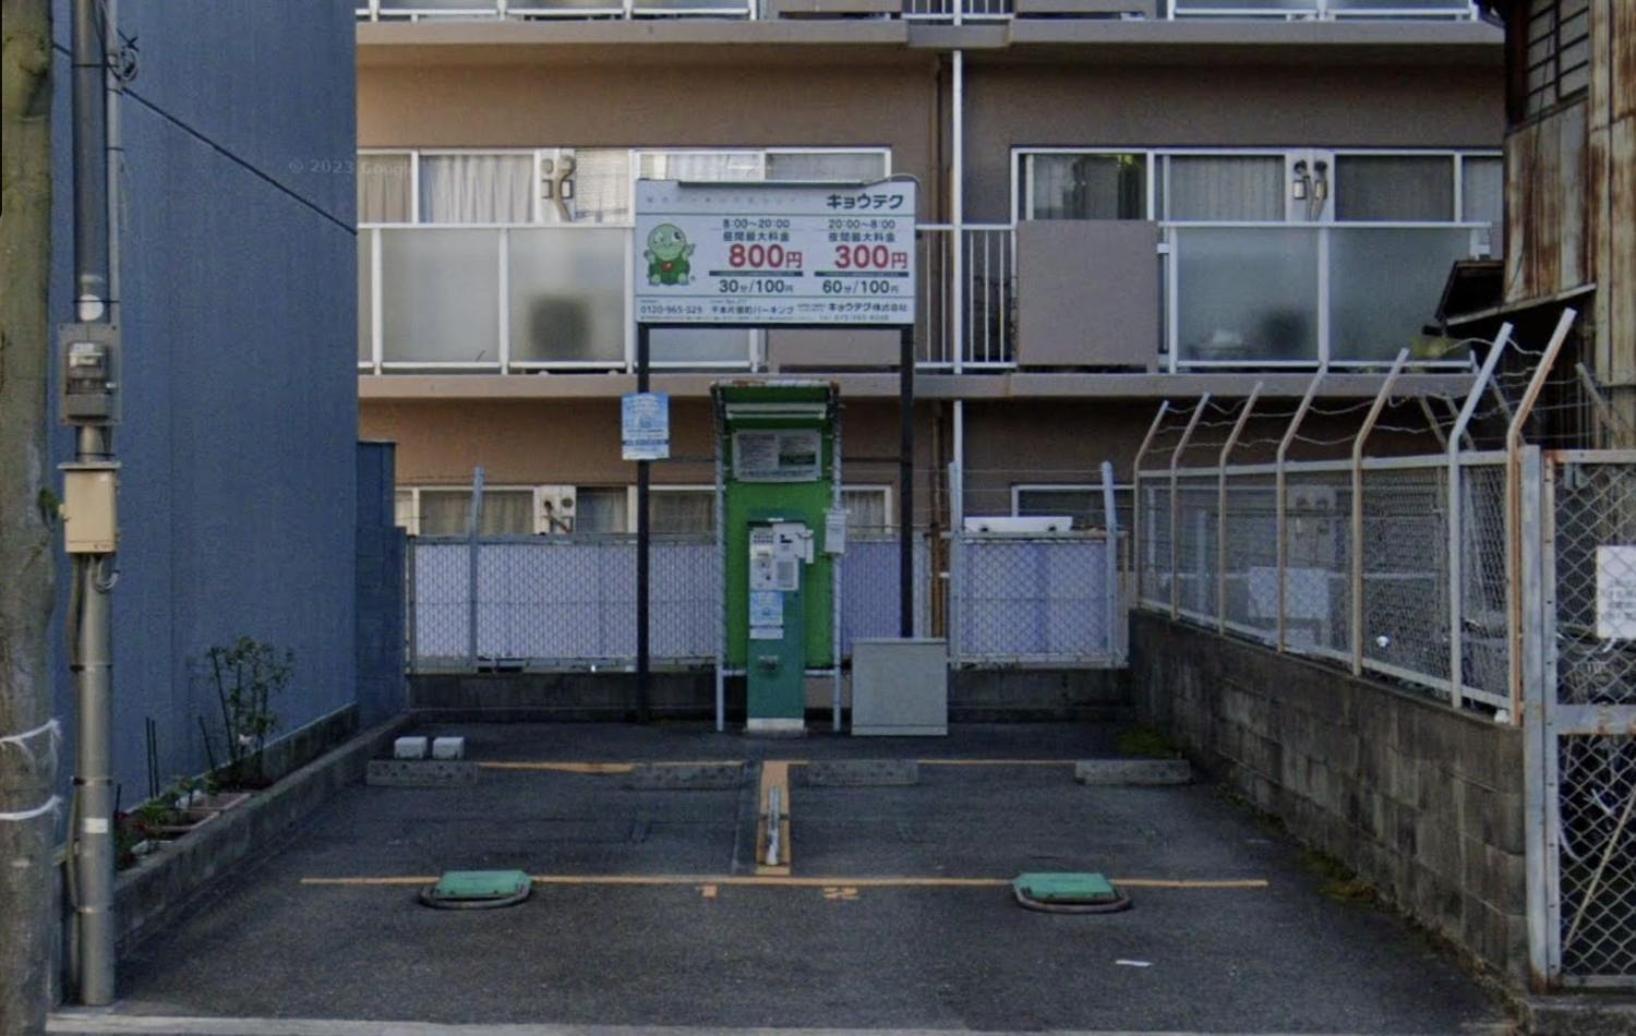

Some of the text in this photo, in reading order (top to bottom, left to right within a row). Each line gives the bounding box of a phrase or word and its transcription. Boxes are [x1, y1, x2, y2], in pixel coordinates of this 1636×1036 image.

[826, 194, 904, 210] キョウテク
[728, 243, 802, 269] 800円
[834, 244, 908, 270] 300円
[719, 279, 794, 294] 30分/100円
[822, 280, 899, 294] 60分/100円
[828, 302, 907, 313] キョウテク株式会社
